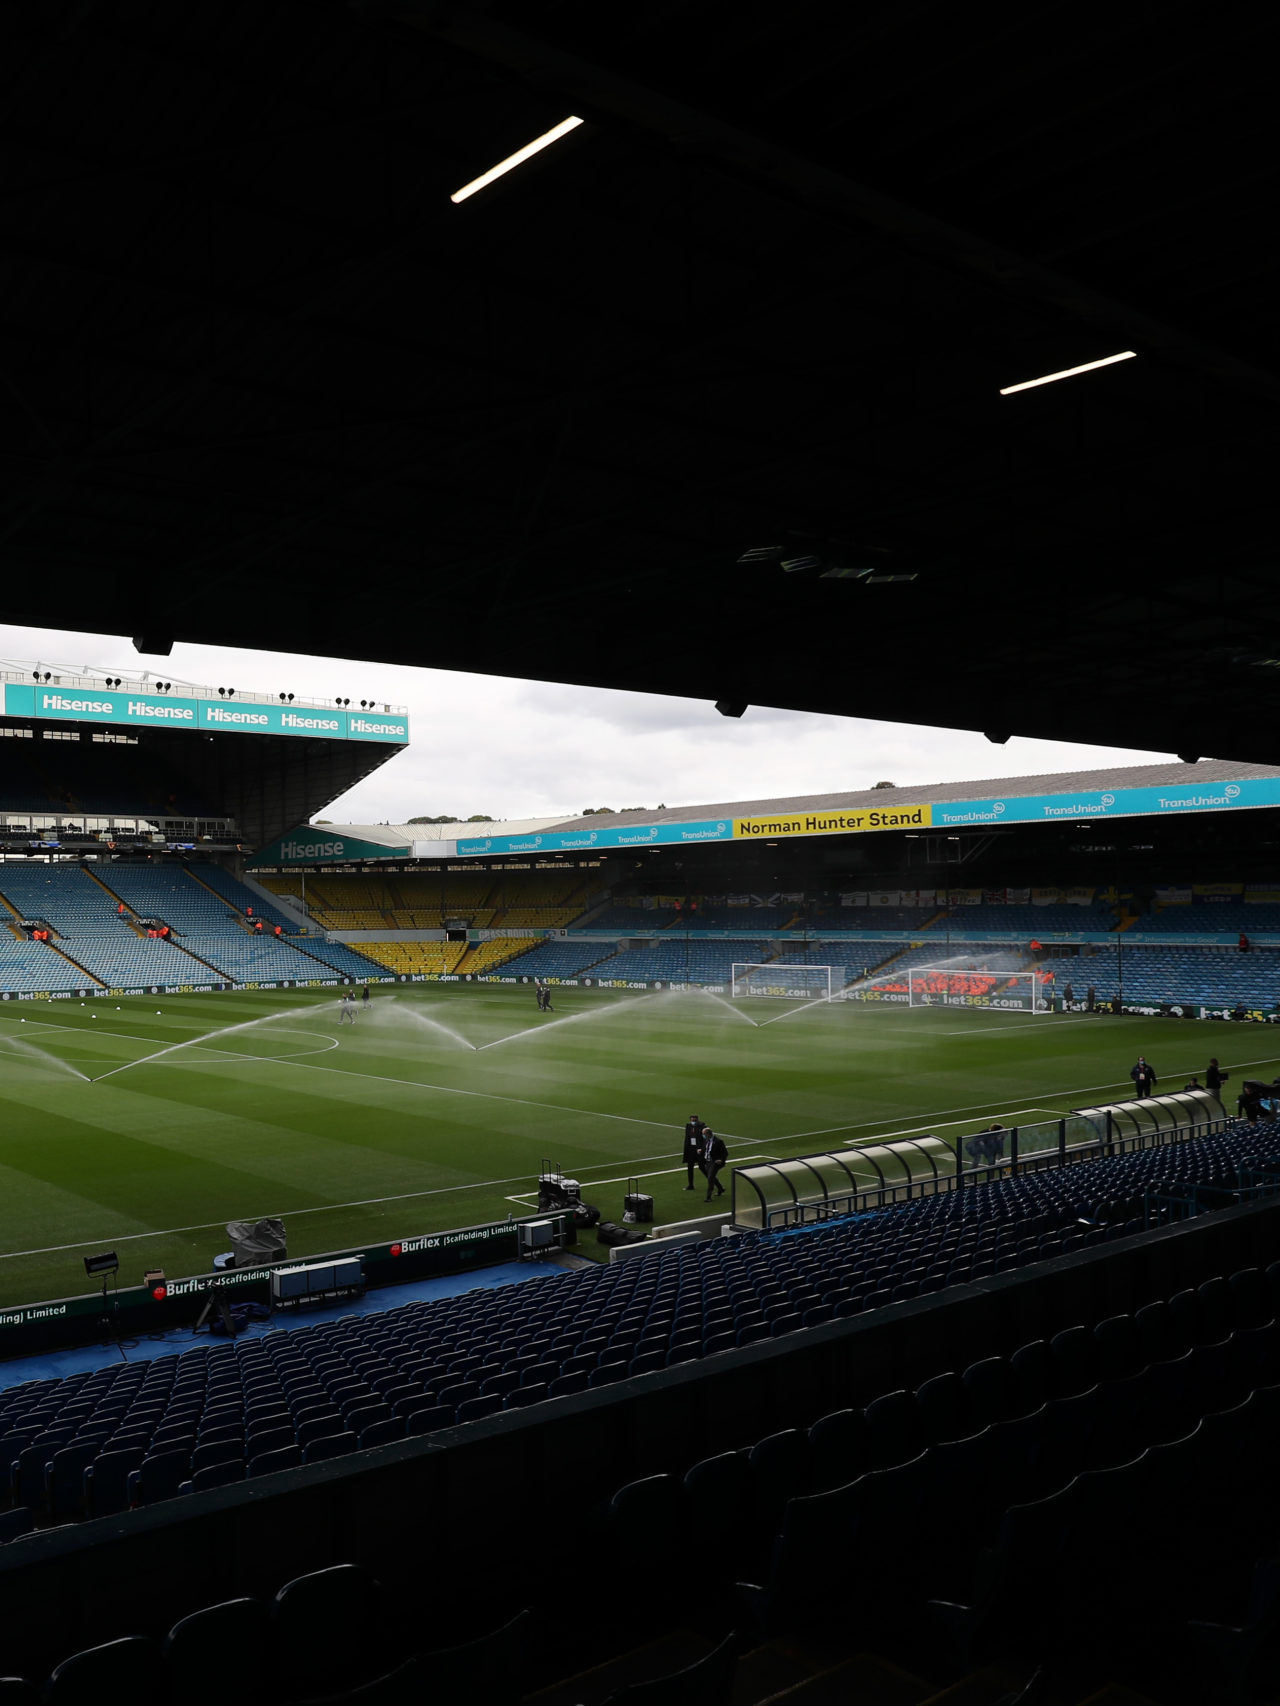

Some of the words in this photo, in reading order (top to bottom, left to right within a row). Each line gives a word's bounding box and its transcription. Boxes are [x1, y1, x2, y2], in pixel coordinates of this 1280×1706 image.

[42, 694, 113, 714] Hisense
[127, 701, 194, 720] Hisense
[206, 707, 269, 725] Hisense
[281, 713, 339, 731] Hisense
[350, 719, 405, 735] Hisense
[1158, 796, 1229, 808] TransUnion
[1043, 804, 1106, 816] TransUnion
[740, 819, 801, 835] Norman
[806, 814, 865, 831] Hunter
[869, 809, 922, 827] Stand
[942, 812, 997, 823] TransUnion
[618, 835, 653, 843] TransUnion
[681, 831, 720, 839] TransUnion
[560, 839, 593, 847] TransUnion
[280, 841, 344, 859] Hisense
[296, 979, 338, 988] bet365.com
[355, 976, 396, 985] bet365.com
[412, 974, 459, 982] bet365.com
[477, 975, 517, 984] bet365.com
[535, 976, 578, 986] bt365.com
[598, 979, 647, 989] bet365.com
[165, 984, 212, 993] bet365.com
[233, 981, 277, 990] bet365.com
[749, 985, 811, 997] bet365.com
[18, 991, 71, 1000] bet365.com
[94, 987, 144, 997] bet365.com
[840, 989, 910, 1002] bet365.com
[943, 993, 1023, 1008] bet365.com
[401, 1236, 440, 1253] Burflex
[443, 1229, 490, 1246] (Scaffolding)
[491, 1224, 517, 1236] Limited
[166, 1279, 213, 1297] Burflex
[27, 1305, 66, 1320] Limited
